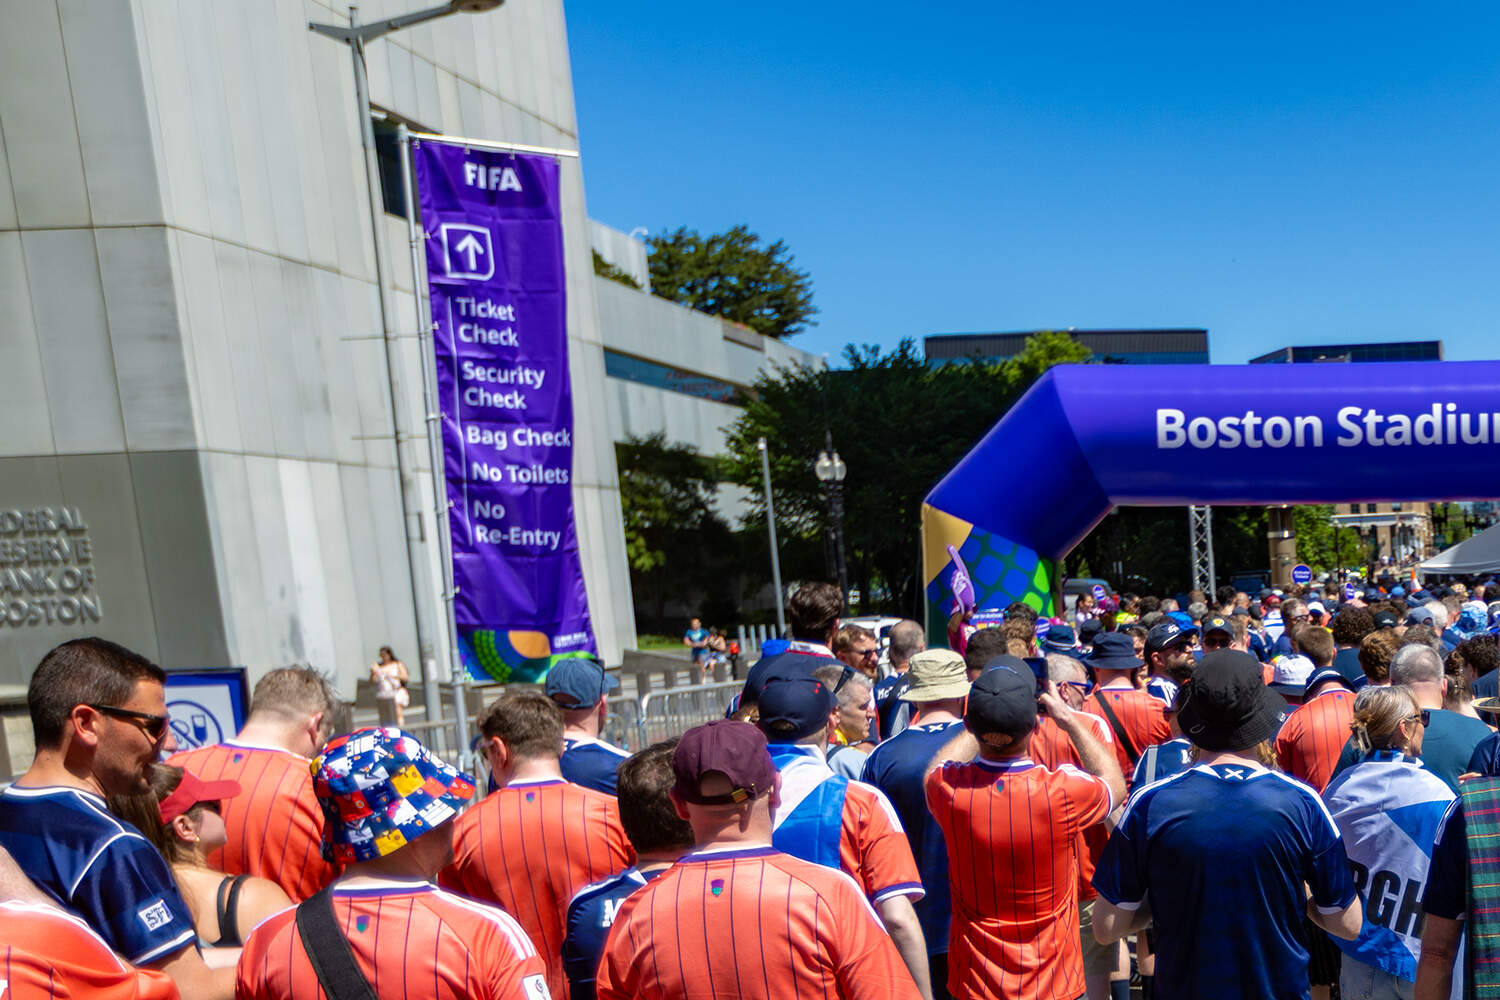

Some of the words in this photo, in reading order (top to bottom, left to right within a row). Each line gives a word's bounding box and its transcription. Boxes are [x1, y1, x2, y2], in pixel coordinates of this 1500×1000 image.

[464, 161, 523, 192] FIFA
[455, 296, 516, 322] Ticket
[458, 322, 520, 348] Check
[462, 360, 545, 390] Security
[463, 386, 527, 410] Check
[466, 424, 508, 451] Bag
[512, 427, 571, 447] Check
[1155, 407, 1323, 449] Boston
[471, 461, 503, 482] No
[505, 464, 569, 485] Toilets
[473, 500, 506, 519] No
[475, 524, 561, 551] Re-Entry
[60, 565, 96, 594] OF
